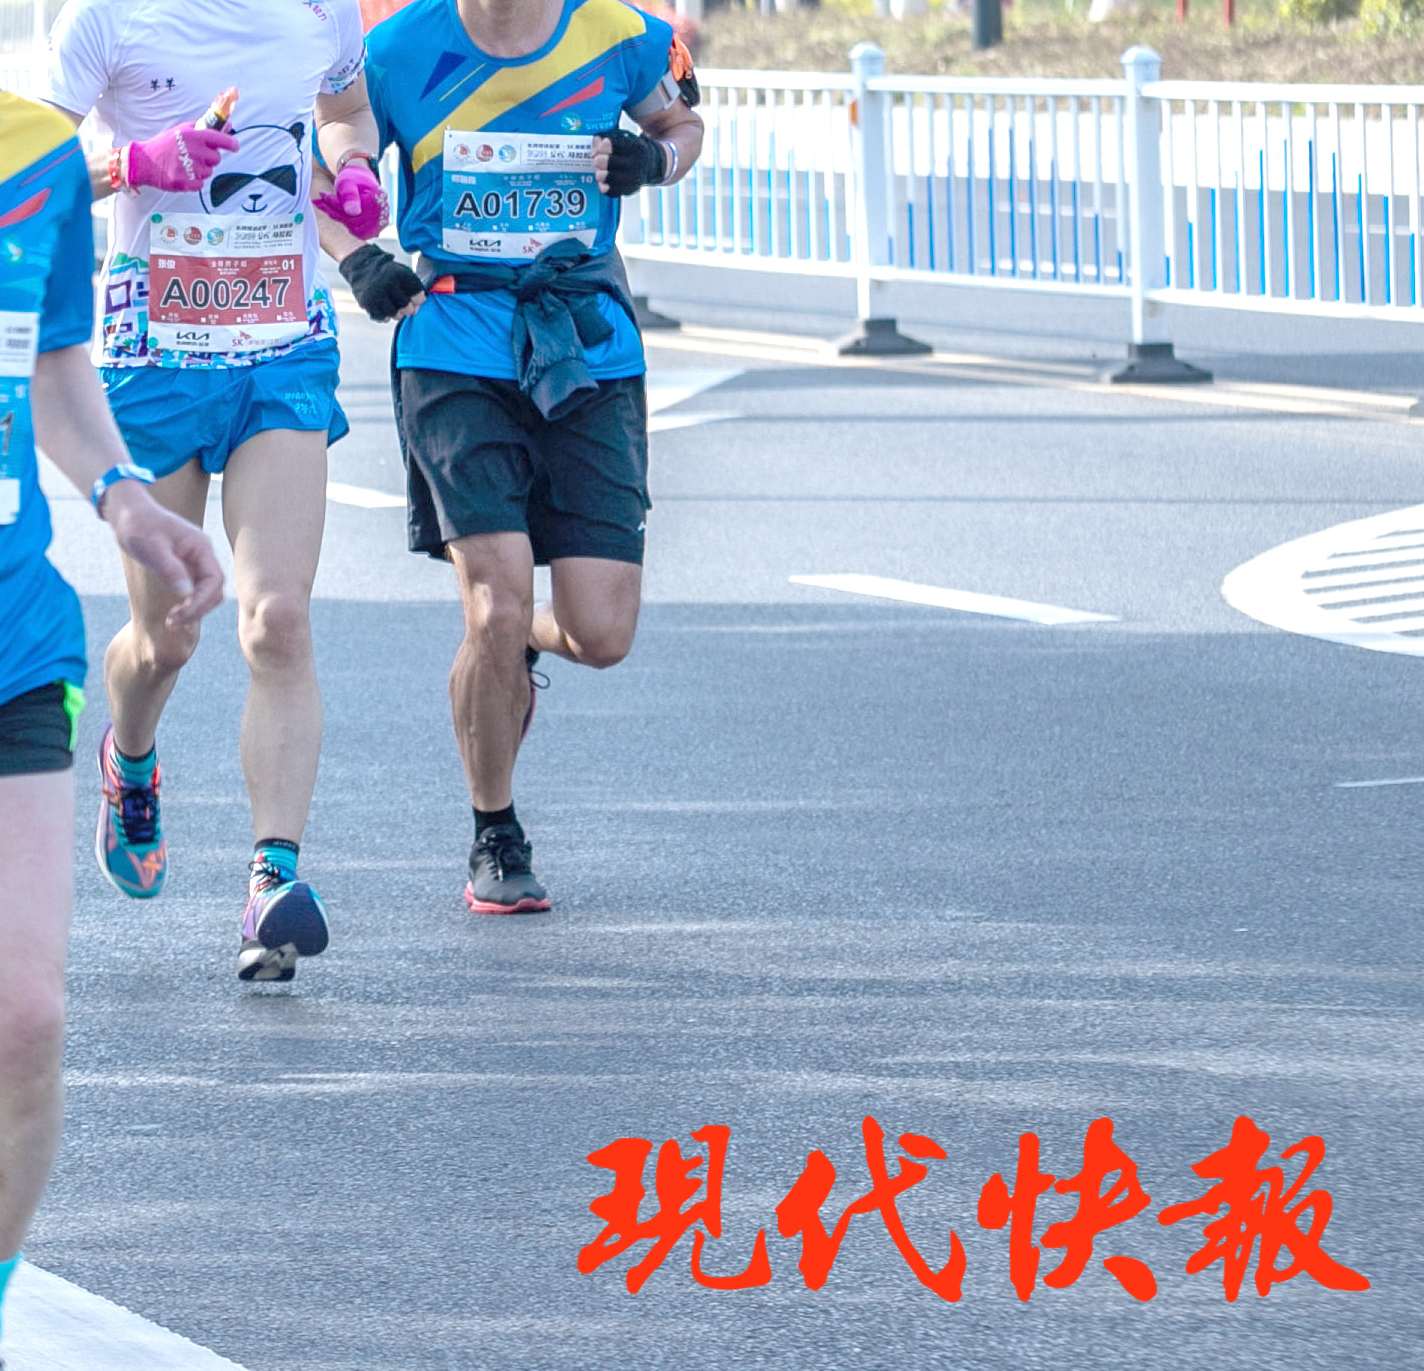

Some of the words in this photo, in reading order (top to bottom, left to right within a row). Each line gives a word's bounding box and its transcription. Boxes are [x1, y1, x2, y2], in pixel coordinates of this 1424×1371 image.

[453, 187, 587, 219] A01739
[282, 259, 295, 270] 01
[160, 276, 291, 310] A00247
